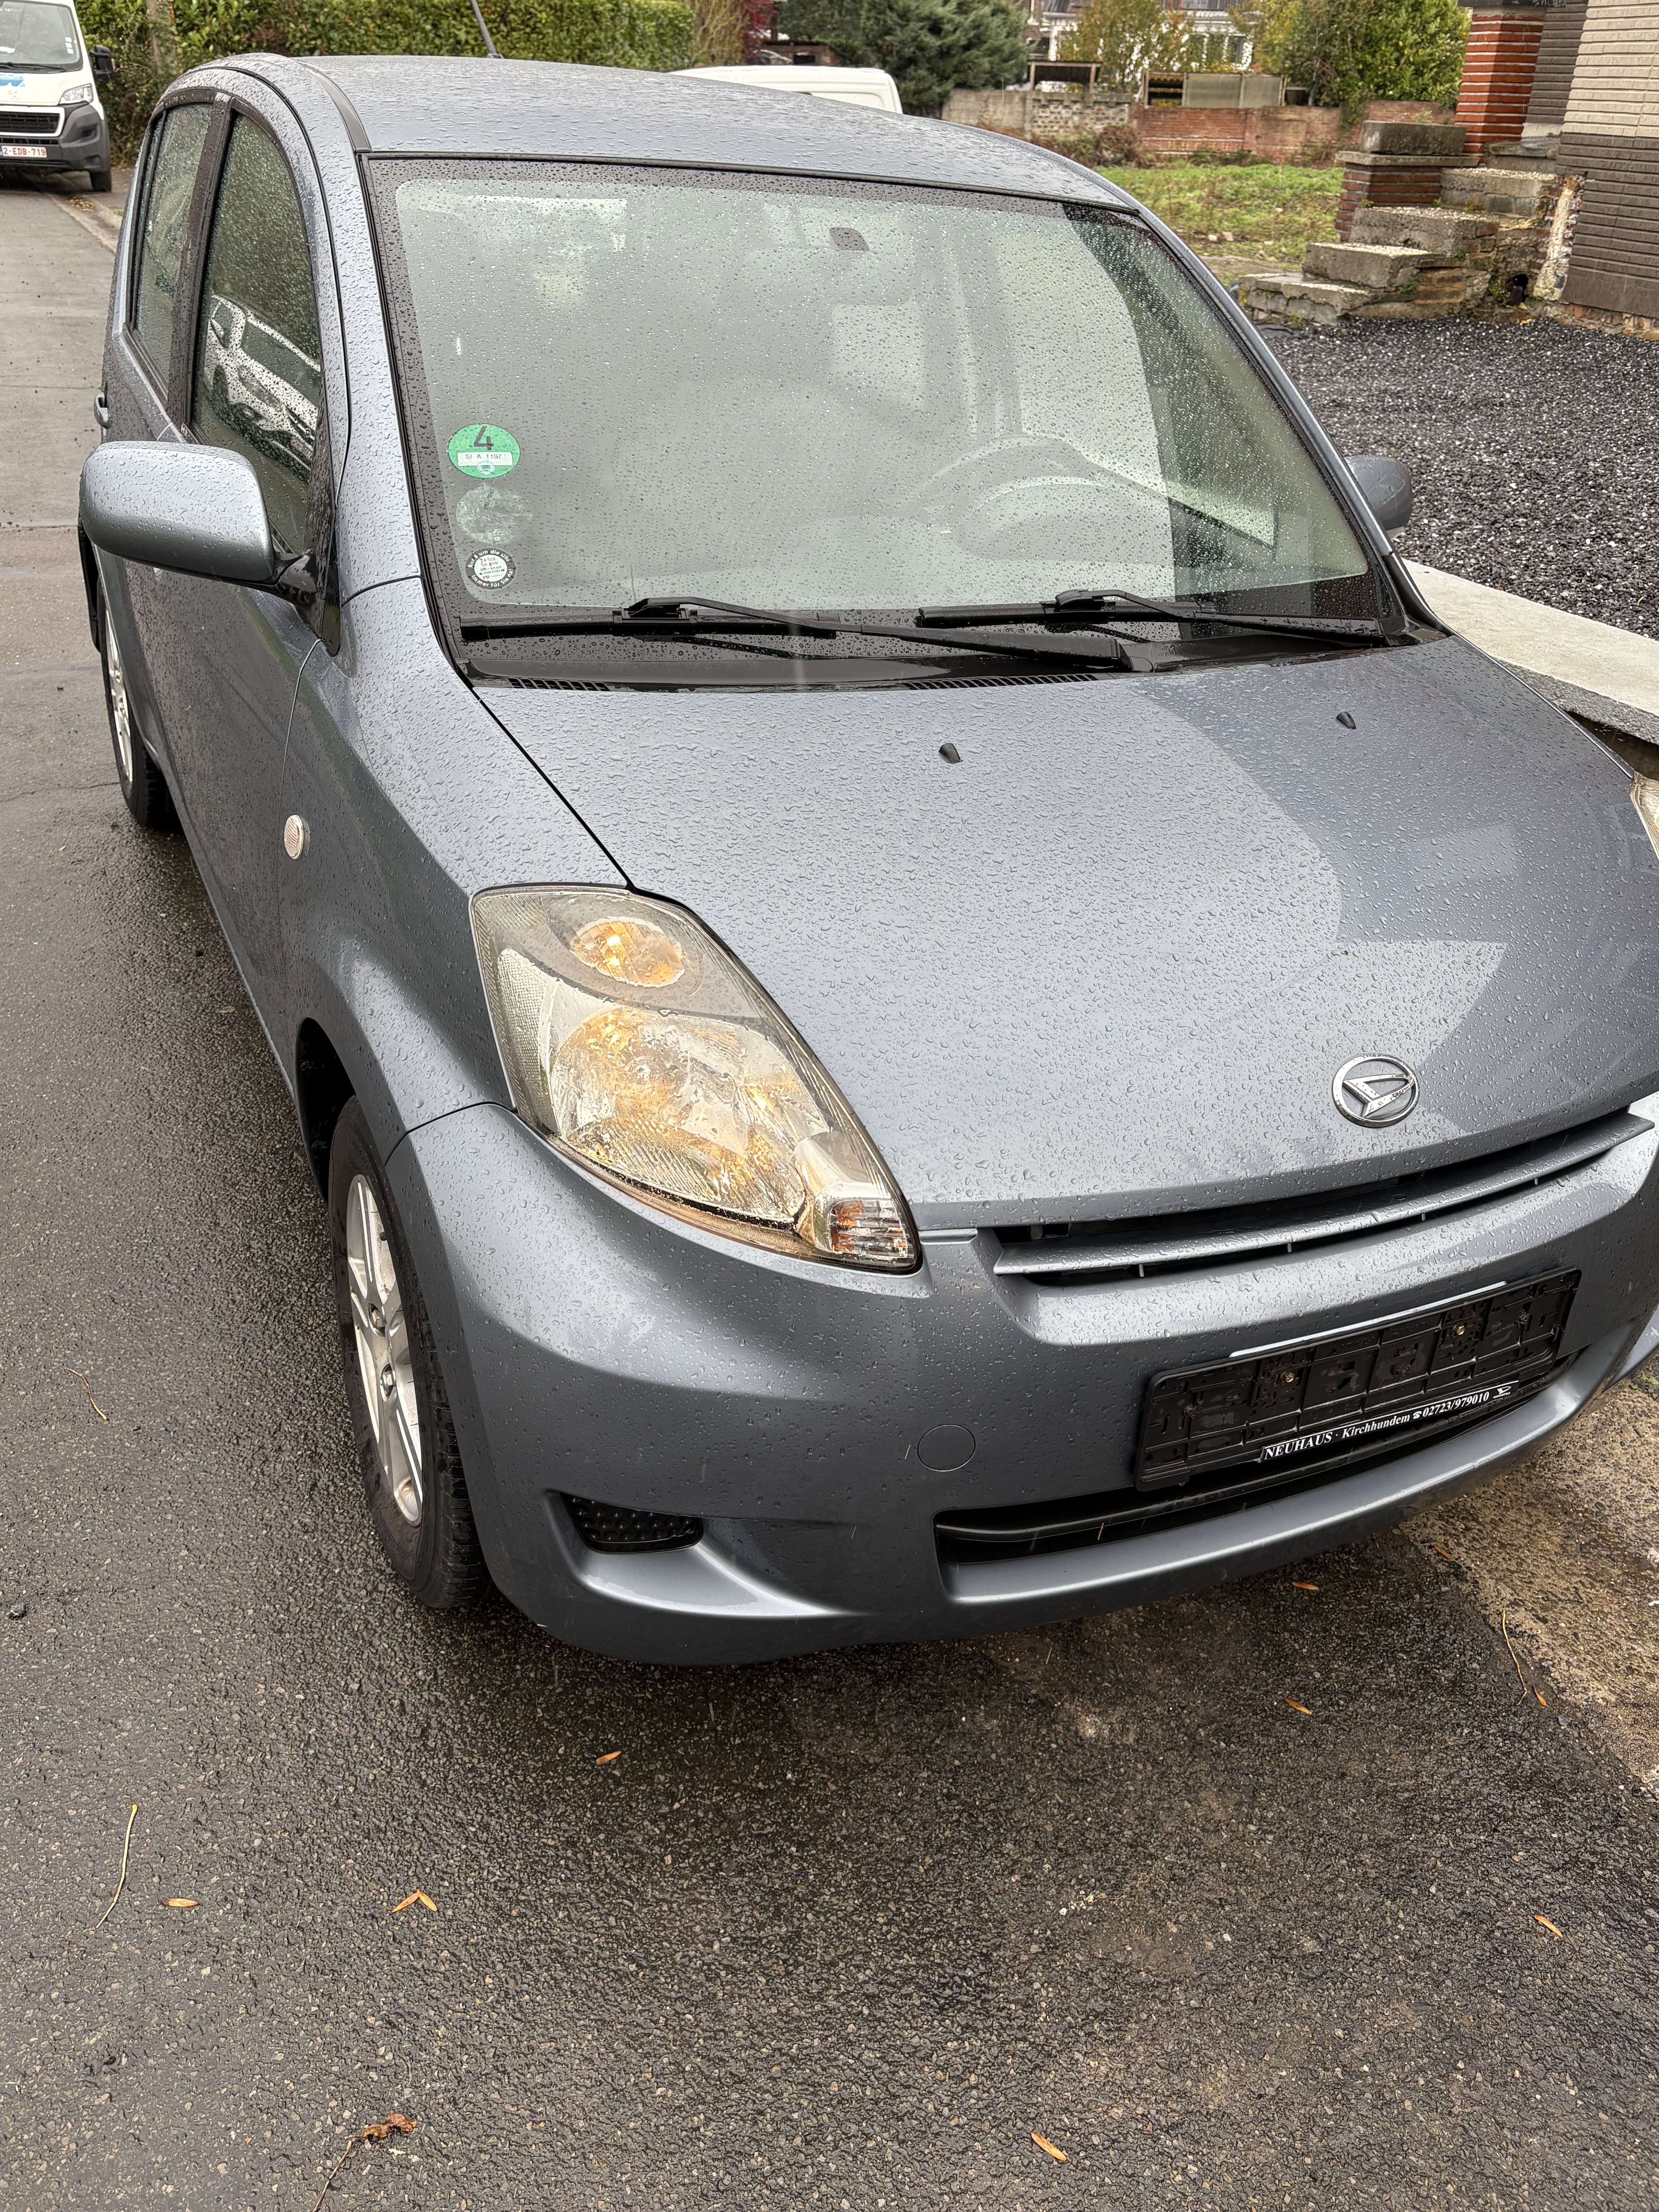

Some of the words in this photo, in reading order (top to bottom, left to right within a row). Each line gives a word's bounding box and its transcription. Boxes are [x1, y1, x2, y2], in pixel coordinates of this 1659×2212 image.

[474, 426, 494, 450] 4
[501, 553, 510, 562] Uhr
[471, 575, 489, 586] Immer
[1264, 1432, 1333, 1460] NEUHAUS
[1341, 1414, 1410, 1439] Kirchhundem
[1422, 1391, 1490, 1417] 02723/979010
